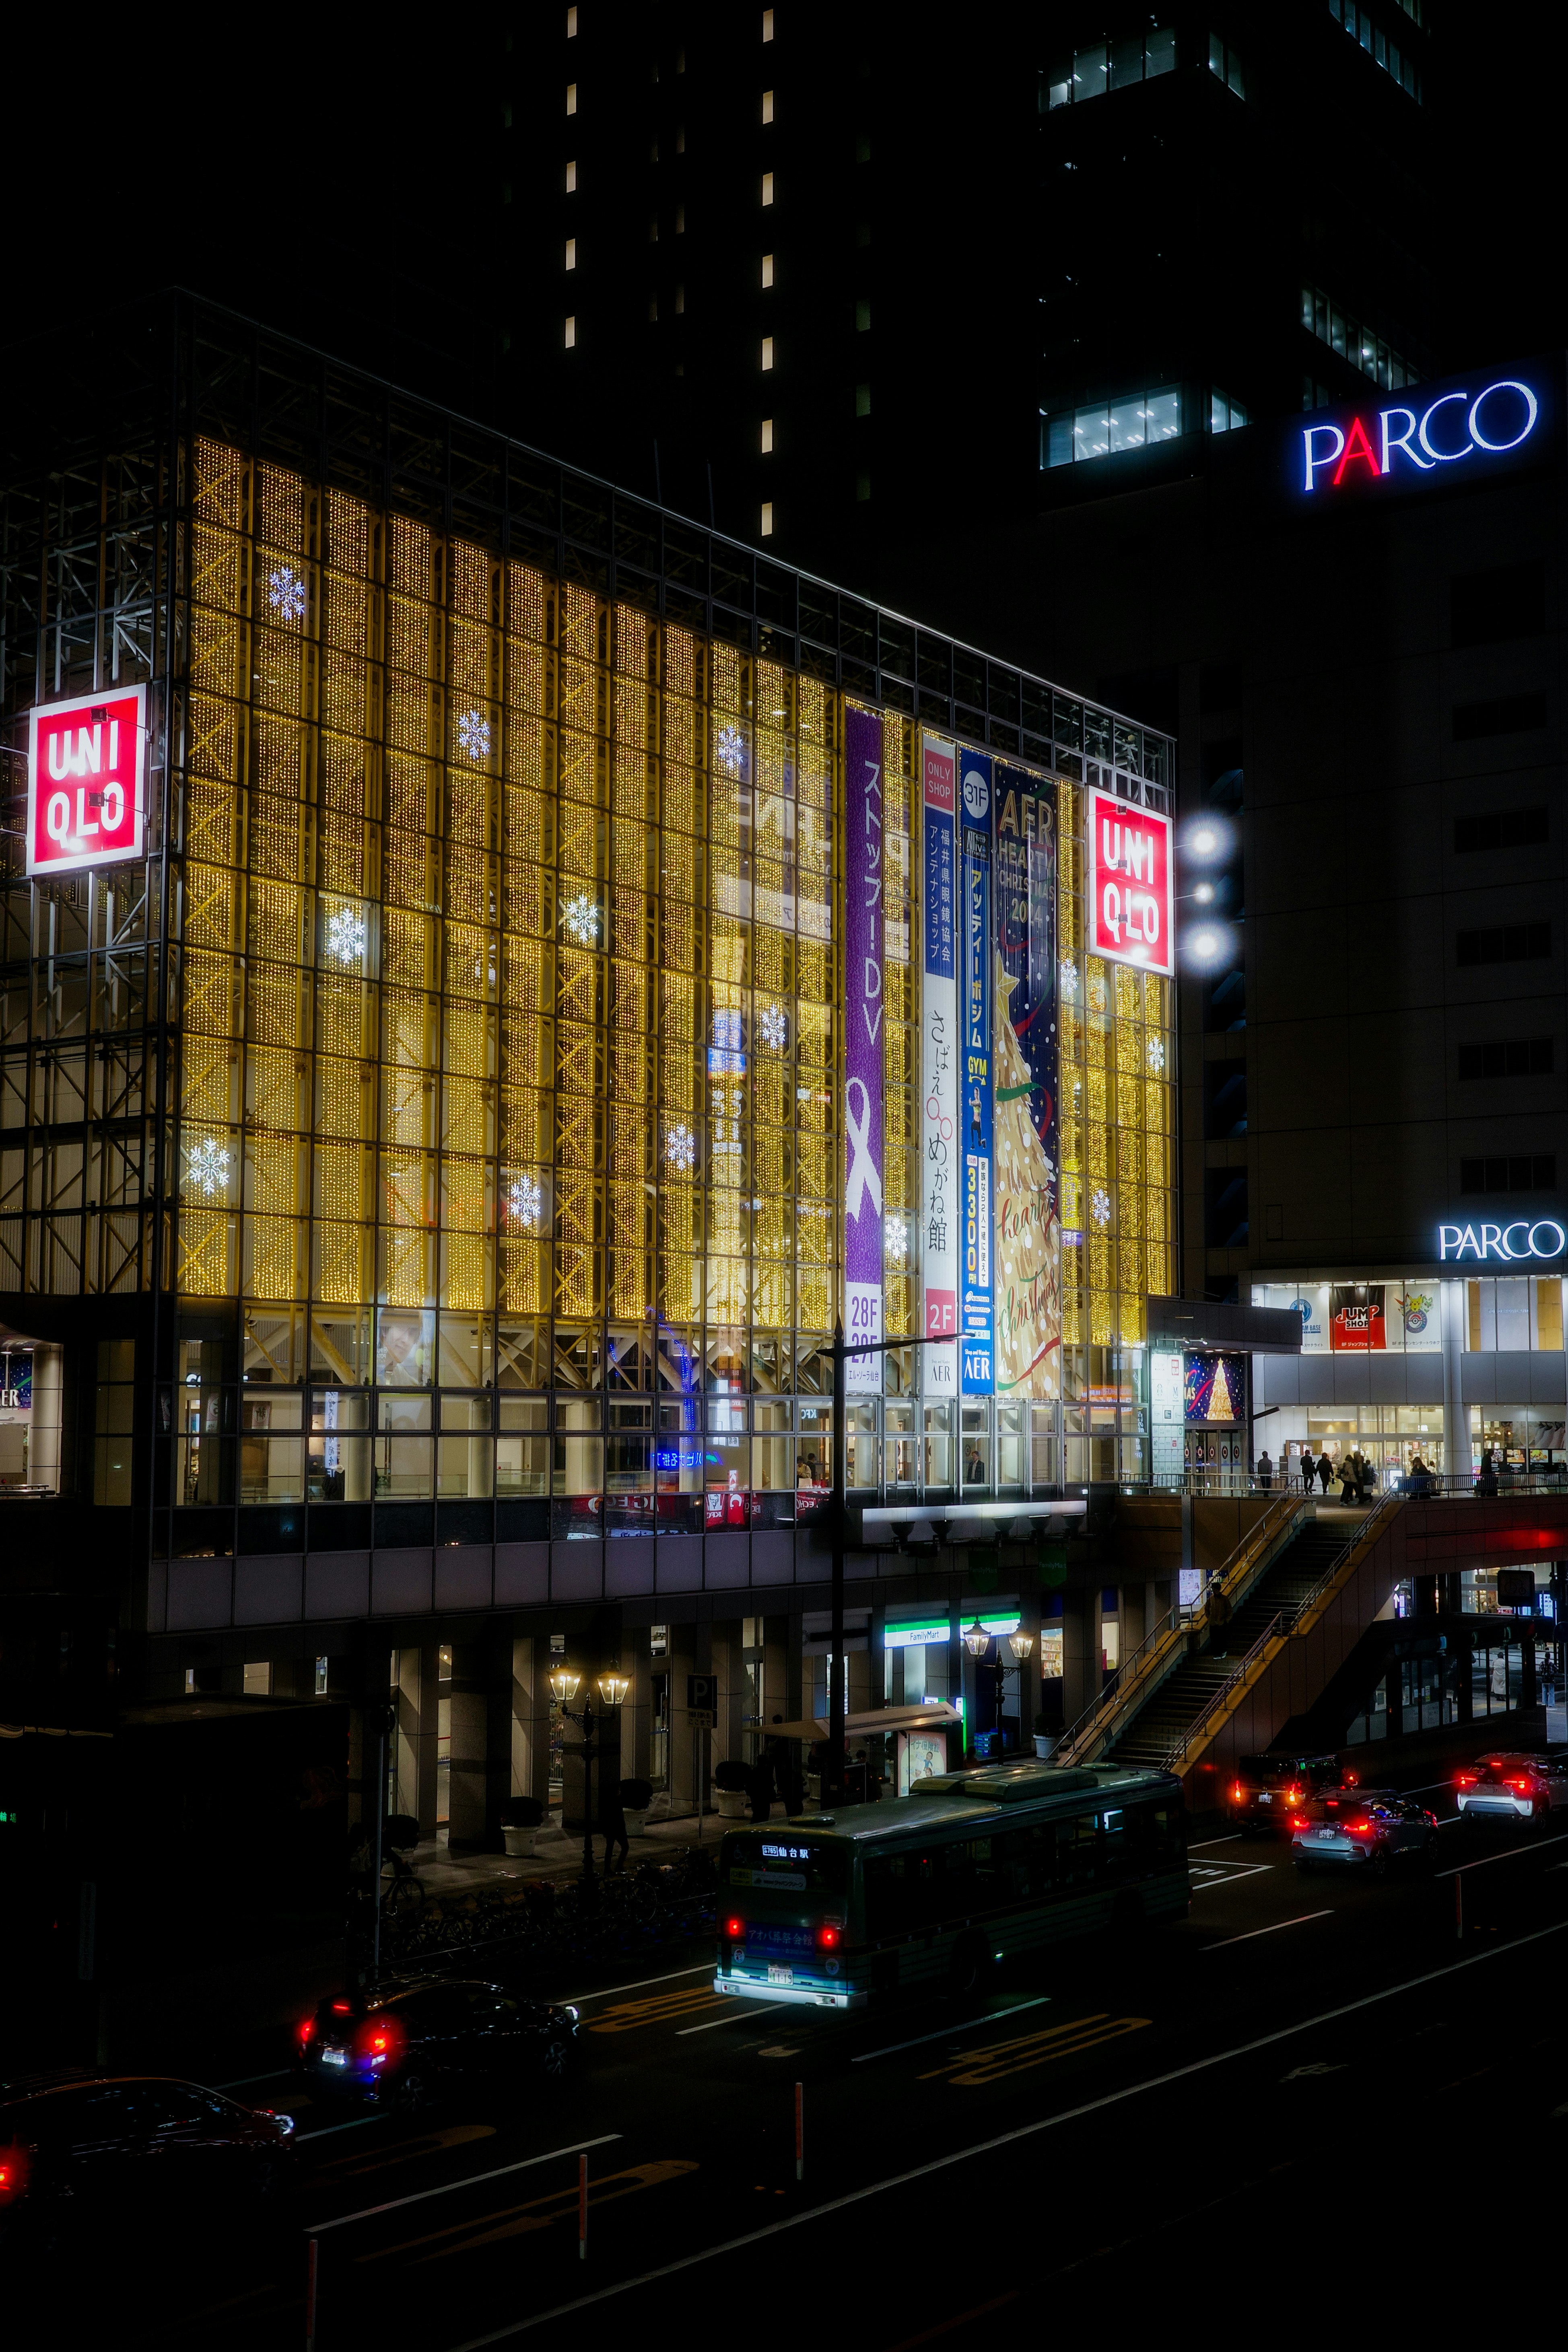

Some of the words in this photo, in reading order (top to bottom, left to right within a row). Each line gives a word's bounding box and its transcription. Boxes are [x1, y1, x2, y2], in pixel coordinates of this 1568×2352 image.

[1302, 381, 1538, 491] PARCO
[48, 720, 118, 781] UNI
[928, 761, 950, 781] ONLY
[928, 780, 950, 798] SHOP
[965, 783, 987, 807] 31F
[47, 782, 124, 849] QLO
[999, 789, 1053, 847] AER
[999, 838, 1054, 877] HEARTY
[1104, 818, 1154, 885] UNI
[930, 825, 940, 958] アンテナショップ
[941, 828, 950, 963] 福井県眼鏡協会
[999, 869, 1055, 901] CHRISTMAS
[1012, 898, 1042, 928] 2024
[1104, 882, 1160, 944] QLO
[970, 868, 982, 1048] アッティーボジム
[968, 1055, 987, 1077] GYM
[1438, 1221, 1565, 1260] PARCO
[852, 1296, 877, 1328] 28F
[929, 1304, 952, 1330] 2F
[1335, 1305, 1380, 1324] JUMP
[851, 1332, 877, 1364] 29F
[849, 1370, 879, 1381] エル・ソーラ仙台
[931, 1365, 950, 1381] AER
[964, 1355, 991, 1380] AER
[0, 1389, 19, 1407] ER
[1039, 1561, 1067, 1569] FamilyMart
[910, 1629, 940, 1641] FamilyMart
[694, 1678, 708, 1705] P
[779, 1848, 809, 1859] 仙台駅
[748, 1930, 812, 1946] アオバ葬祭会館
